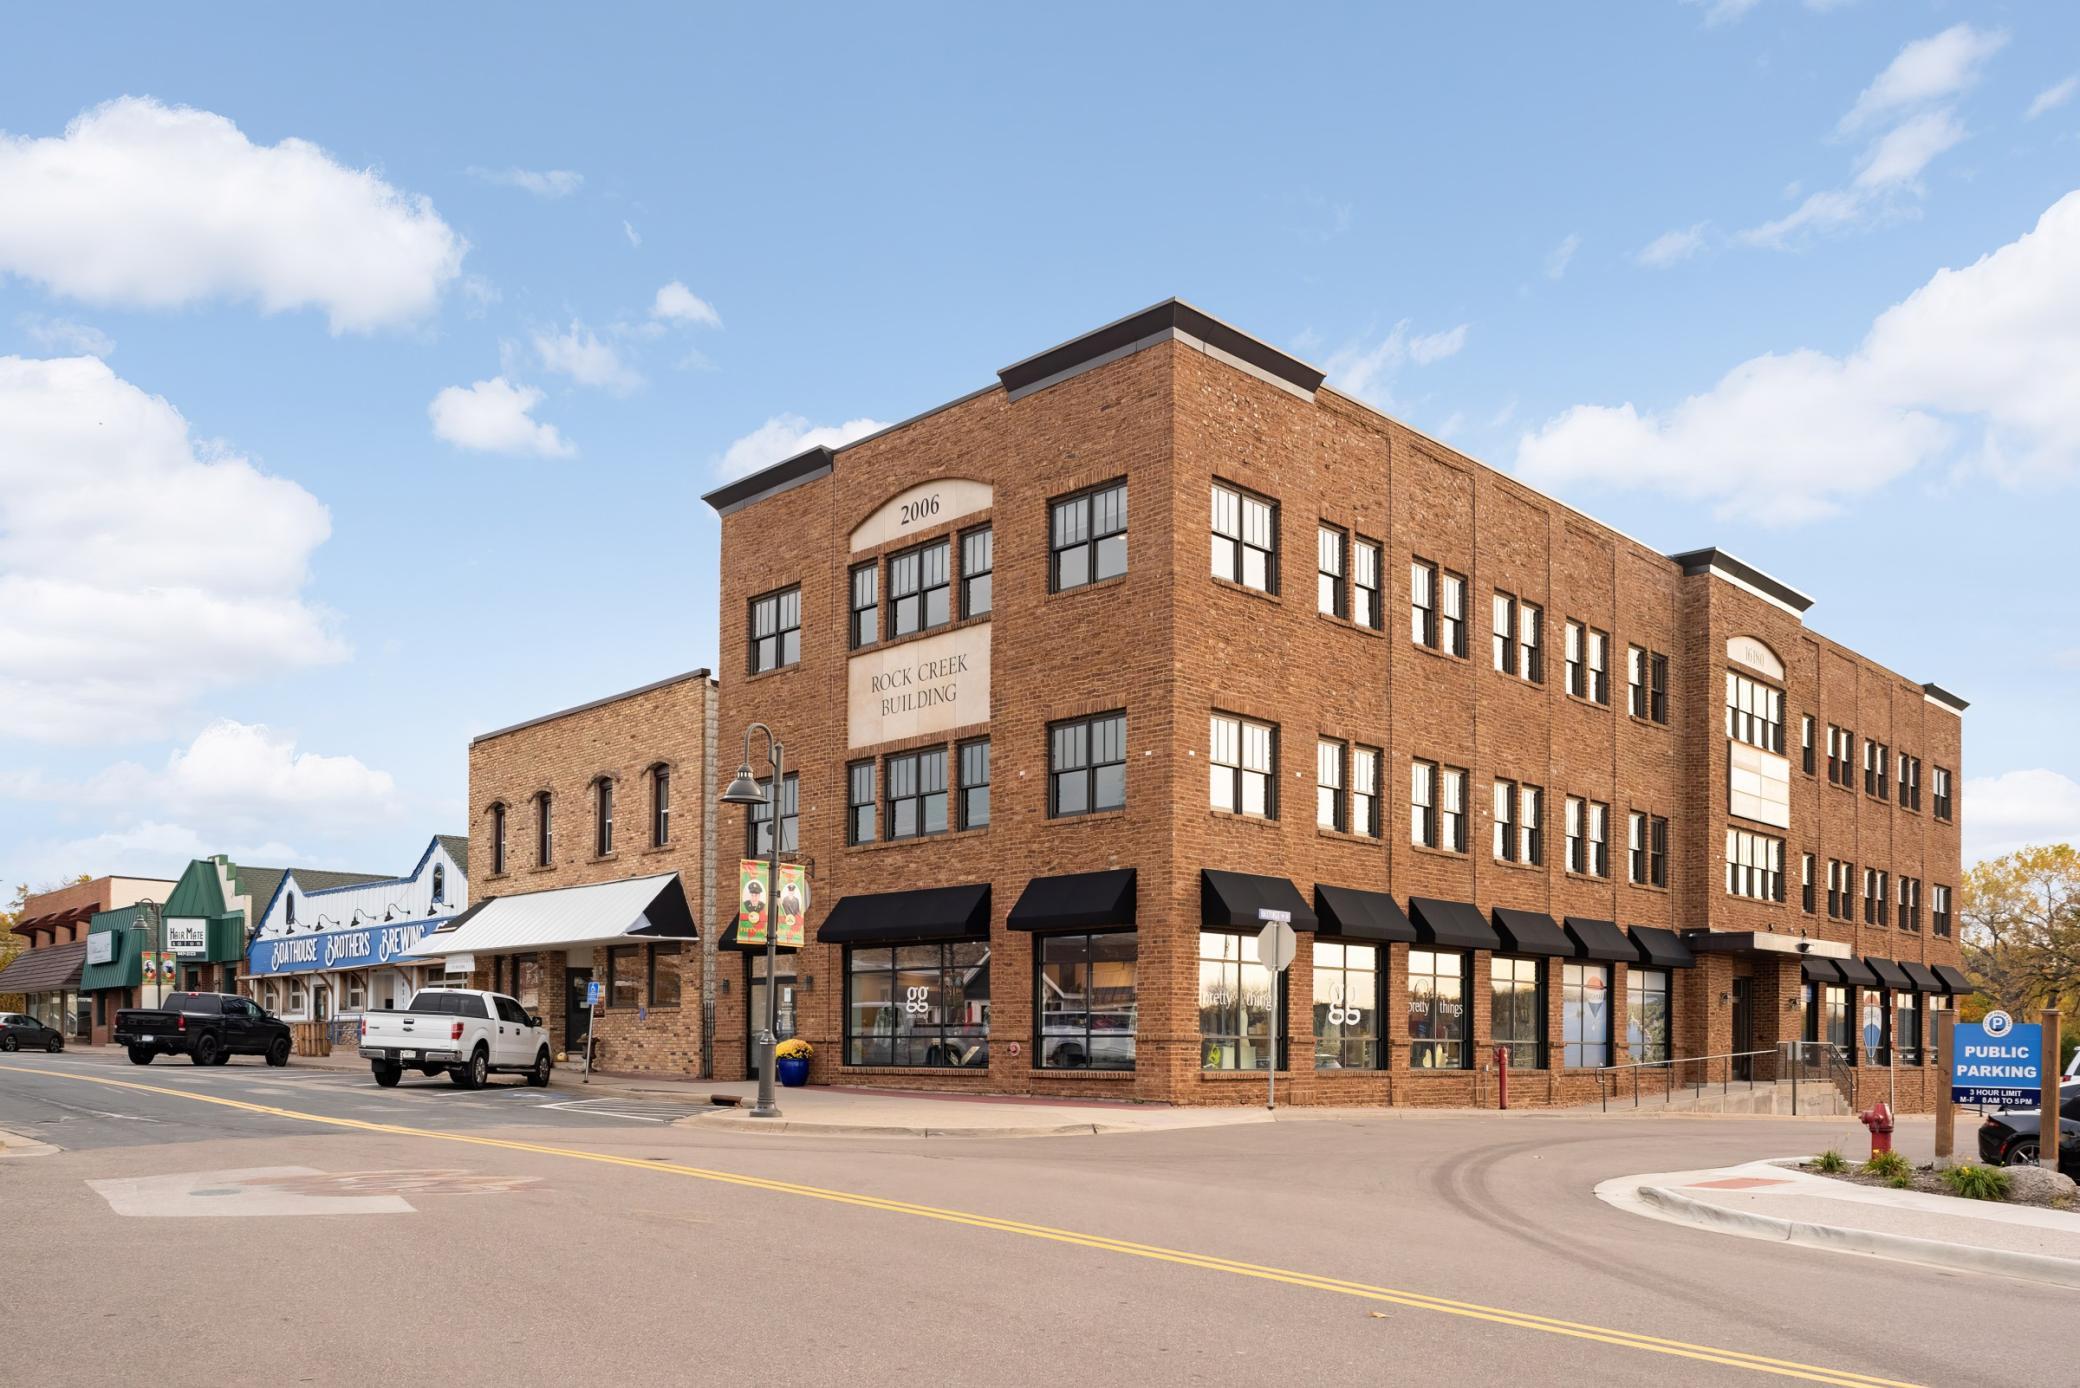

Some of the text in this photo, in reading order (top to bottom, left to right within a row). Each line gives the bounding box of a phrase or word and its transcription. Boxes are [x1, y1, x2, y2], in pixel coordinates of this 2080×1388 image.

[901, 493, 940, 526] 2006
[871, 653, 968, 694] ROCK CREEK
[881, 683, 957, 717] BUILDING
[170, 928, 203, 940] HAIR MATE
[271, 938, 318, 972] BOATHOUSE
[325, 932, 371, 967] BROTHERS
[906, 986, 928, 1012] gg
[1246, 991, 1272, 1011] thing
[1439, 999, 1464, 1018] things
[1965, 1046, 2029, 1058] PUBLIC
[1956, 1065, 2037, 1078] PARKING
